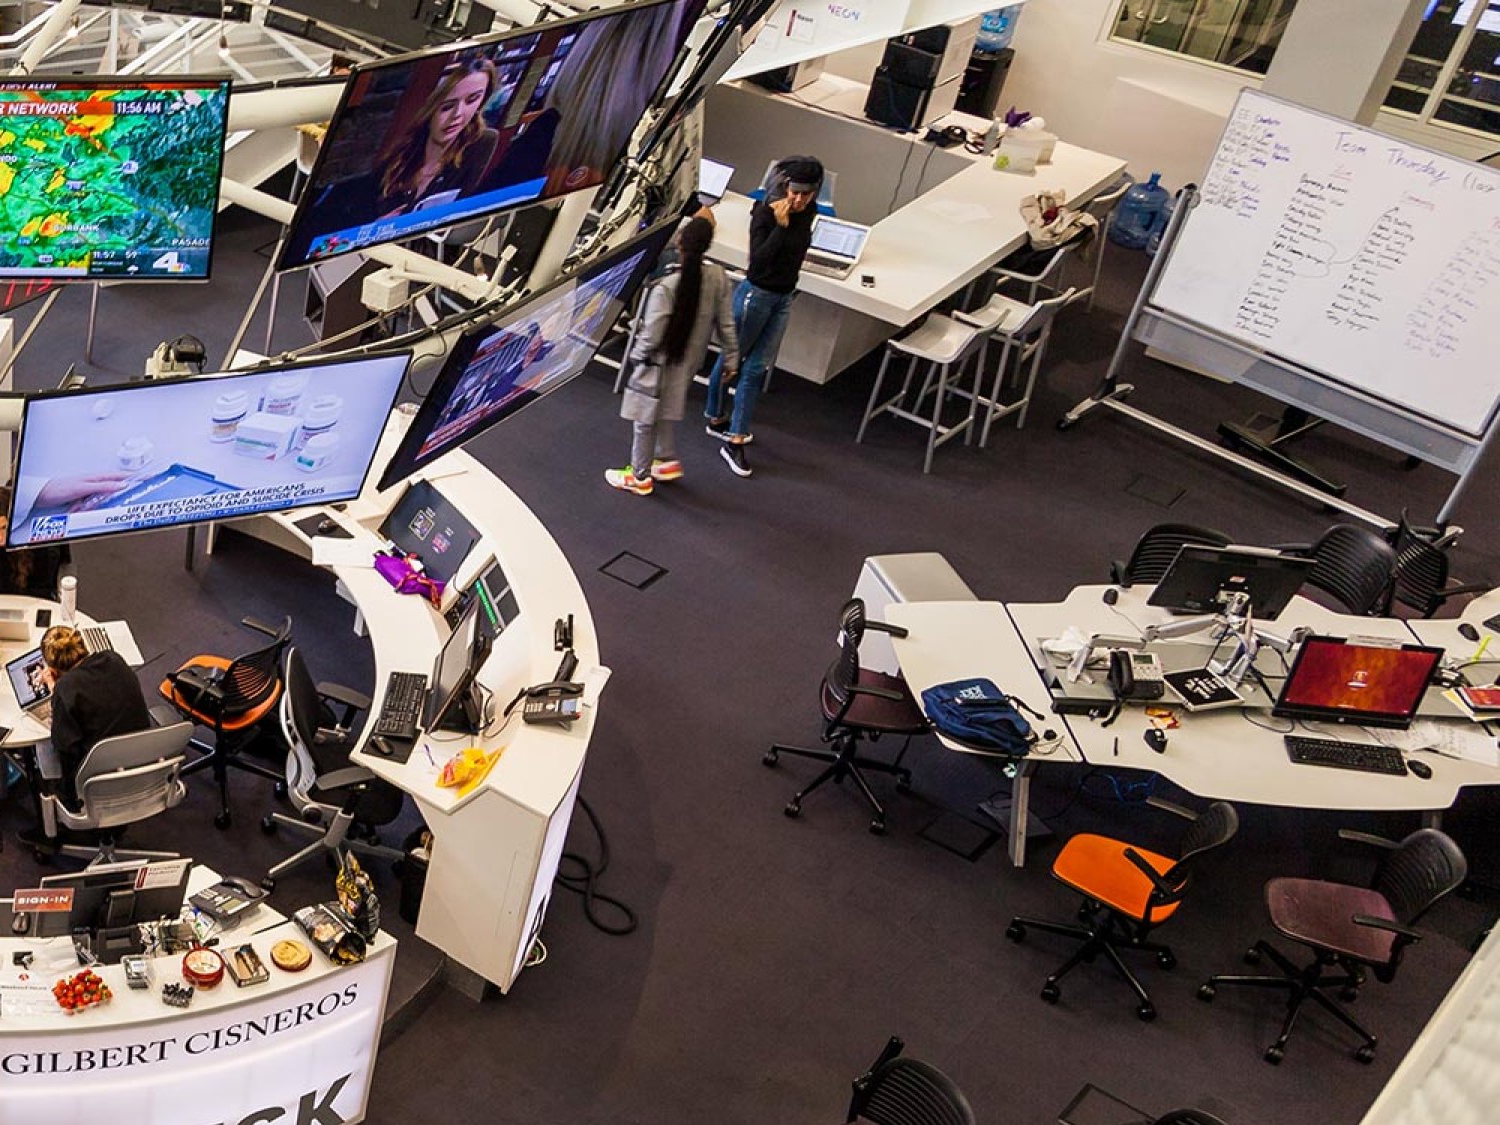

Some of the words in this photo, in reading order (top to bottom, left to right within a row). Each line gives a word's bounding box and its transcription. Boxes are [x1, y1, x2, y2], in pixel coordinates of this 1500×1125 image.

[8, 102, 78, 115] NETWORK
[116, 102, 142, 114] 11:56
[143, 102, 162, 114] AM
[105, 513, 141, 524] DROPS
[143, 509, 163, 518] DUE
[168, 507, 182, 515] TO
[184, 502, 222, 513] OPIOID
[224, 498, 250, 508] AND
[252, 492, 290, 503] SUICIDE
[293, 487, 325, 498] CRISIS
[127, 505, 145, 514] LIFE
[149, 495, 217, 511] EXPECTANCY
[220, 492, 240, 500] FOR
[243, 483, 305, 497] AMERICANS
[17, 895, 70, 905] SIGN-IN
[1, 1038, 177, 1075] GILBERT
[184, 982, 359, 1055] CISNEROS
